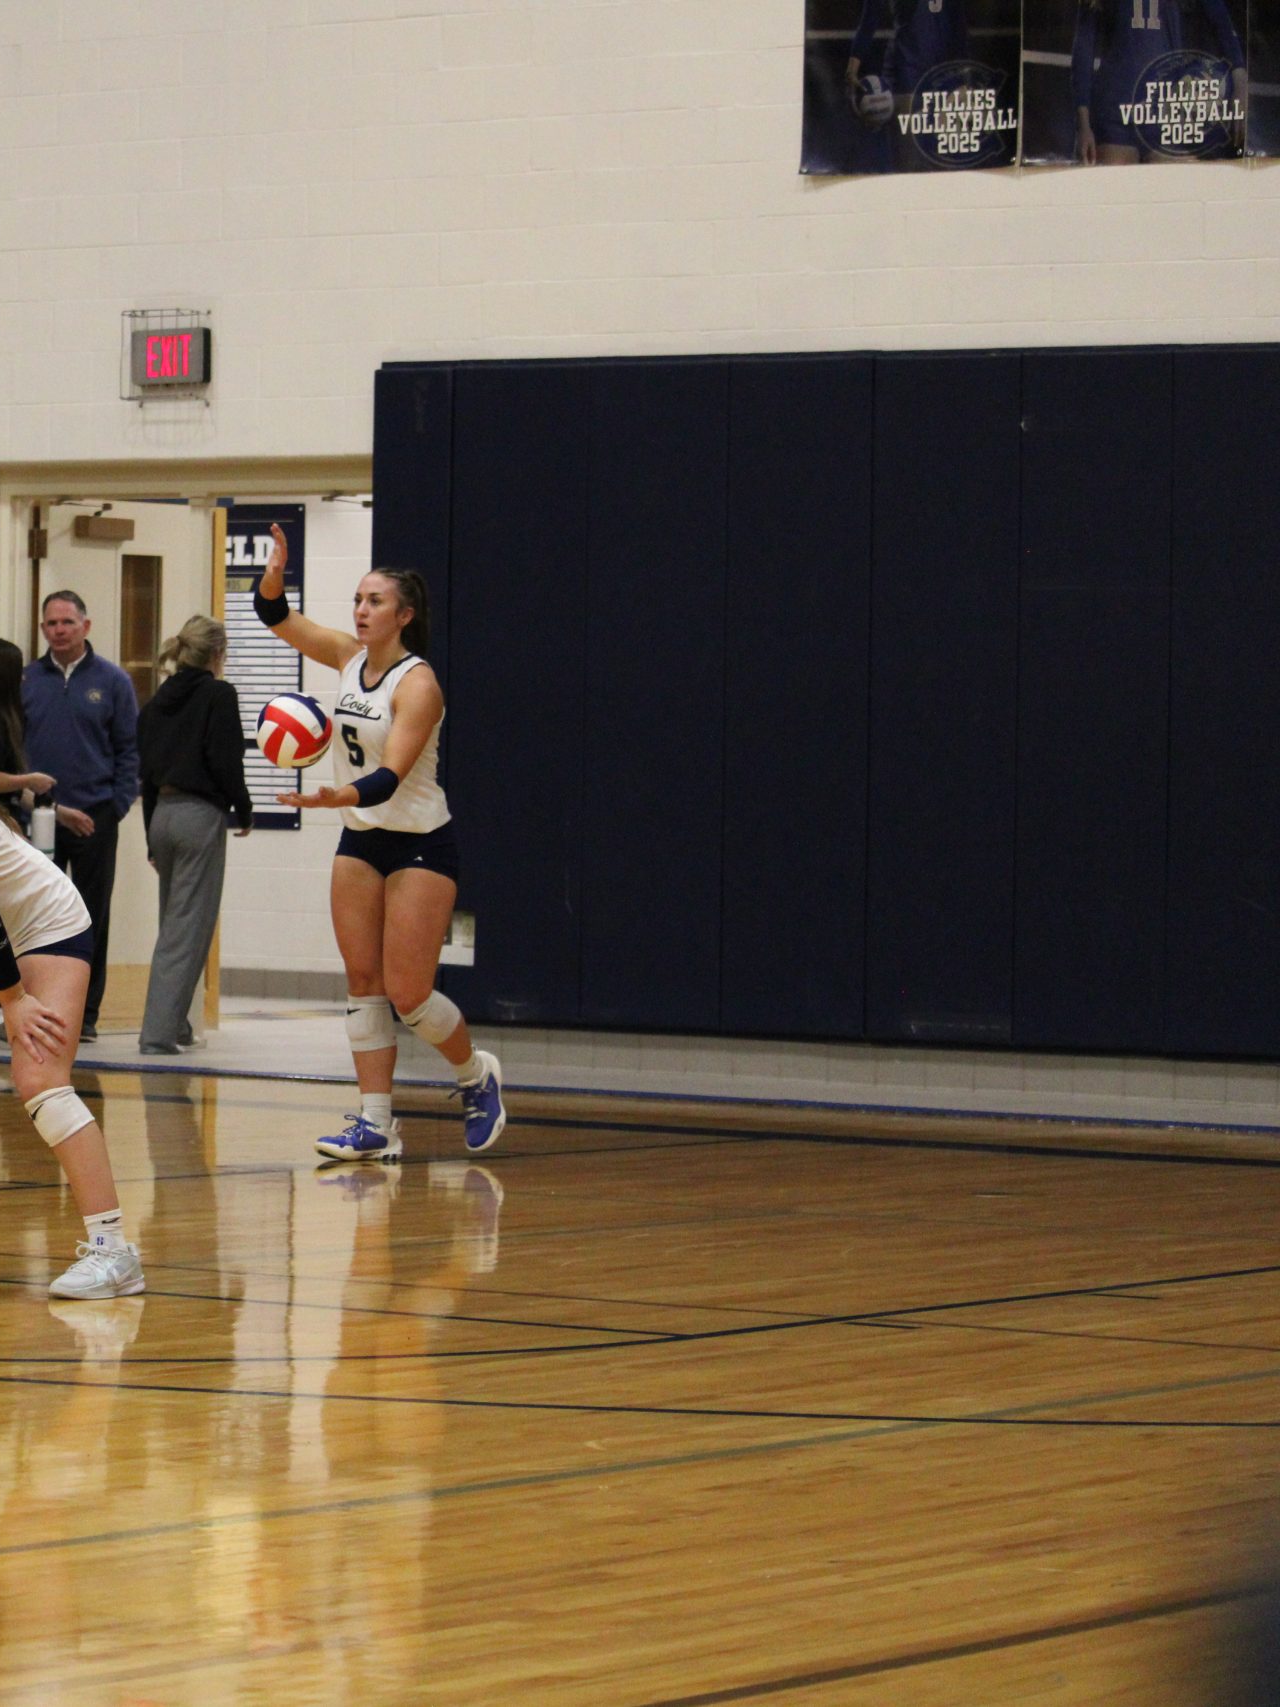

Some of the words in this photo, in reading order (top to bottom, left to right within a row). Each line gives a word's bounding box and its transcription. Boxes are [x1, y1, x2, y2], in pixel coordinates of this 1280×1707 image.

[922, 88, 996, 113] FILLIES
[1146, 79, 1220, 103] FILLIES
[898, 108, 1017, 135] VOLLEYBALL
[1119, 99, 1245, 126] VOLLEYBALL
[937, 131, 980, 154] 2025
[1161, 122, 1205, 145] 2025
[145, 333, 192, 379] EXIT
[340, 693, 373, 717] Cody
[341, 723, 365, 768] 5
